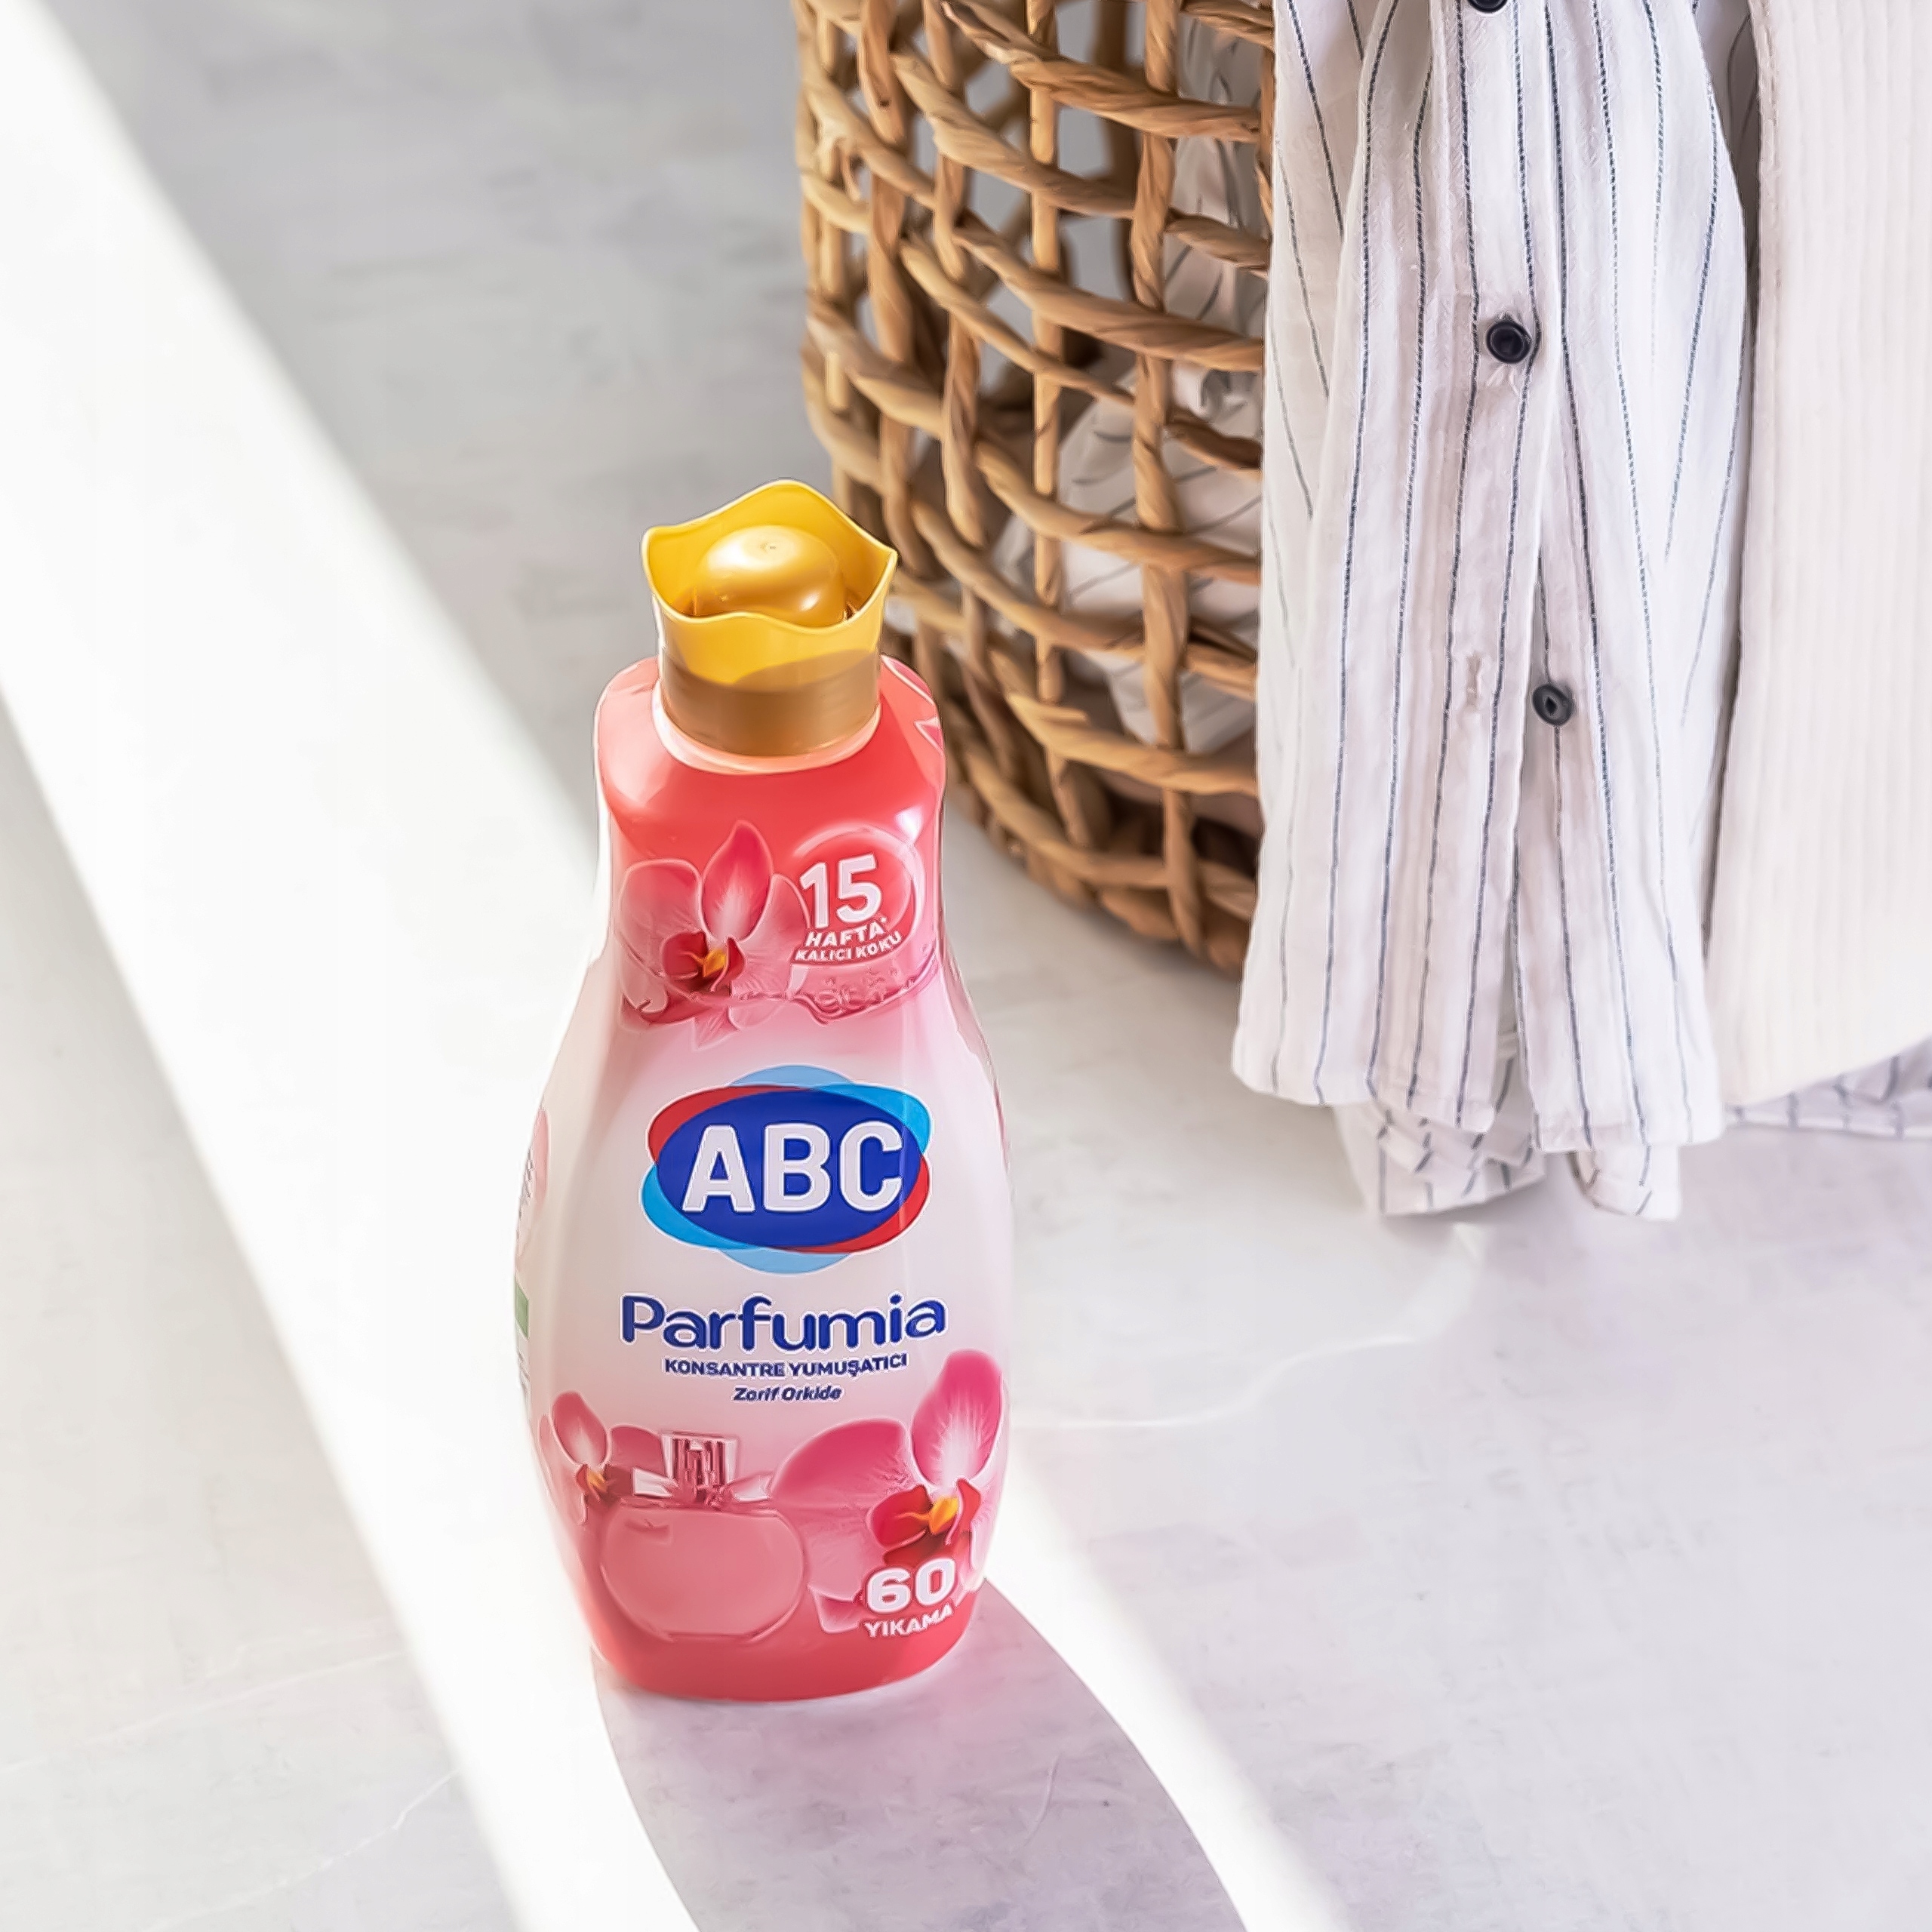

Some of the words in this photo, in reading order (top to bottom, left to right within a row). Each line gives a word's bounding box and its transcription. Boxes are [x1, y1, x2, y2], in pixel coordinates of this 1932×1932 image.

[800, 854, 881, 929] 15
[795, 948, 852, 961] KALICI
[854, 930, 902, 959] KOKU
[681, 1118, 904, 1214] ABC
[620, 1291, 947, 1352] Parfumia
[664, 1357, 786, 1377] KONSANTRE
[789, 1352, 908, 1377] YUMUŞATICI
[732, 1385, 780, 1402] Zarif
[781, 1384, 842, 1401] Orkide
[866, 1557, 956, 1614] 60
[863, 1603, 954, 1638] YIKAMA
